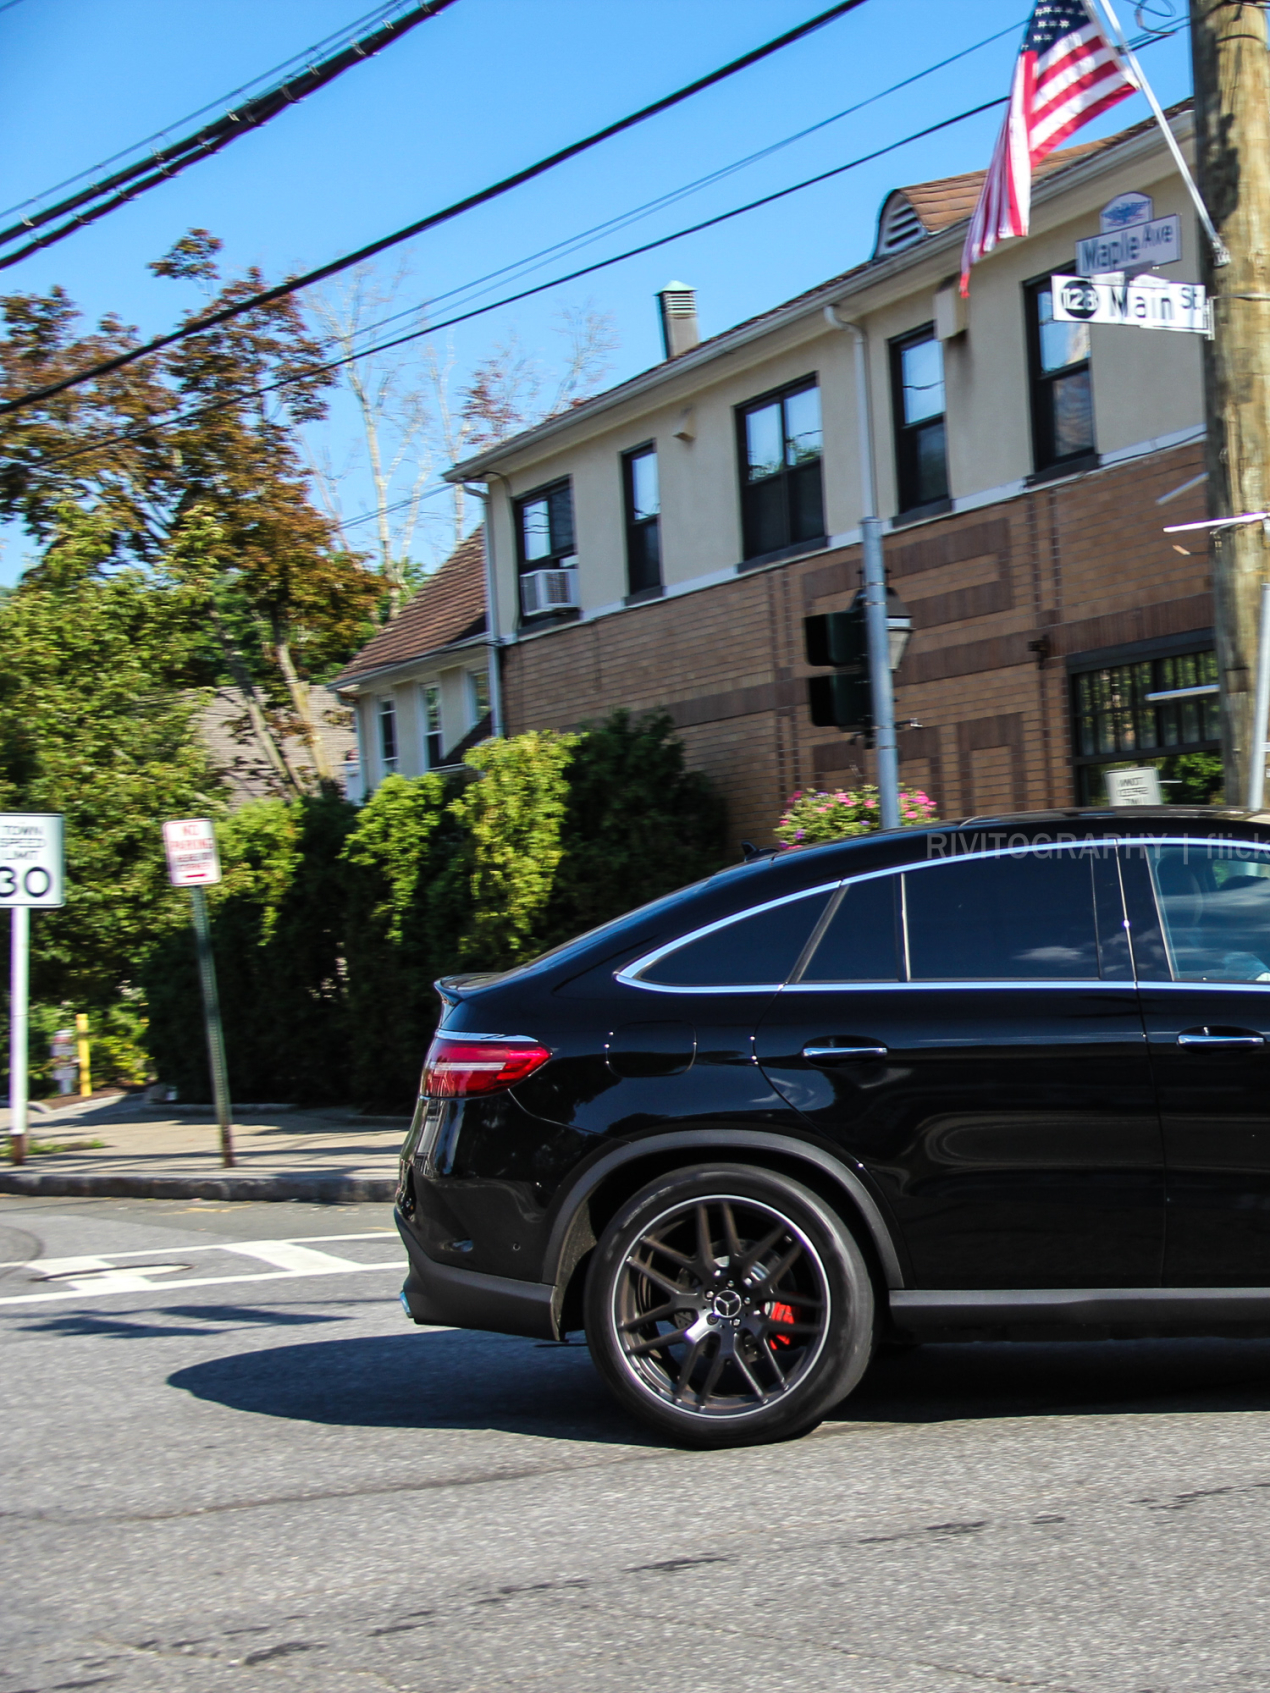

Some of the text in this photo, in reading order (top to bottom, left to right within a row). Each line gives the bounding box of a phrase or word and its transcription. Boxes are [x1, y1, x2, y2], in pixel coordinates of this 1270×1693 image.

[1080, 224, 1174, 273] Maple Ave
[1109, 286, 1175, 320] Main
[1179, 286, 1203, 312] St
[2, 825, 44, 836] TOWN
[0, 837, 47, 848] SPEED
[1, 850, 40, 861] LIMIT
[0, 866, 53, 898] 30
